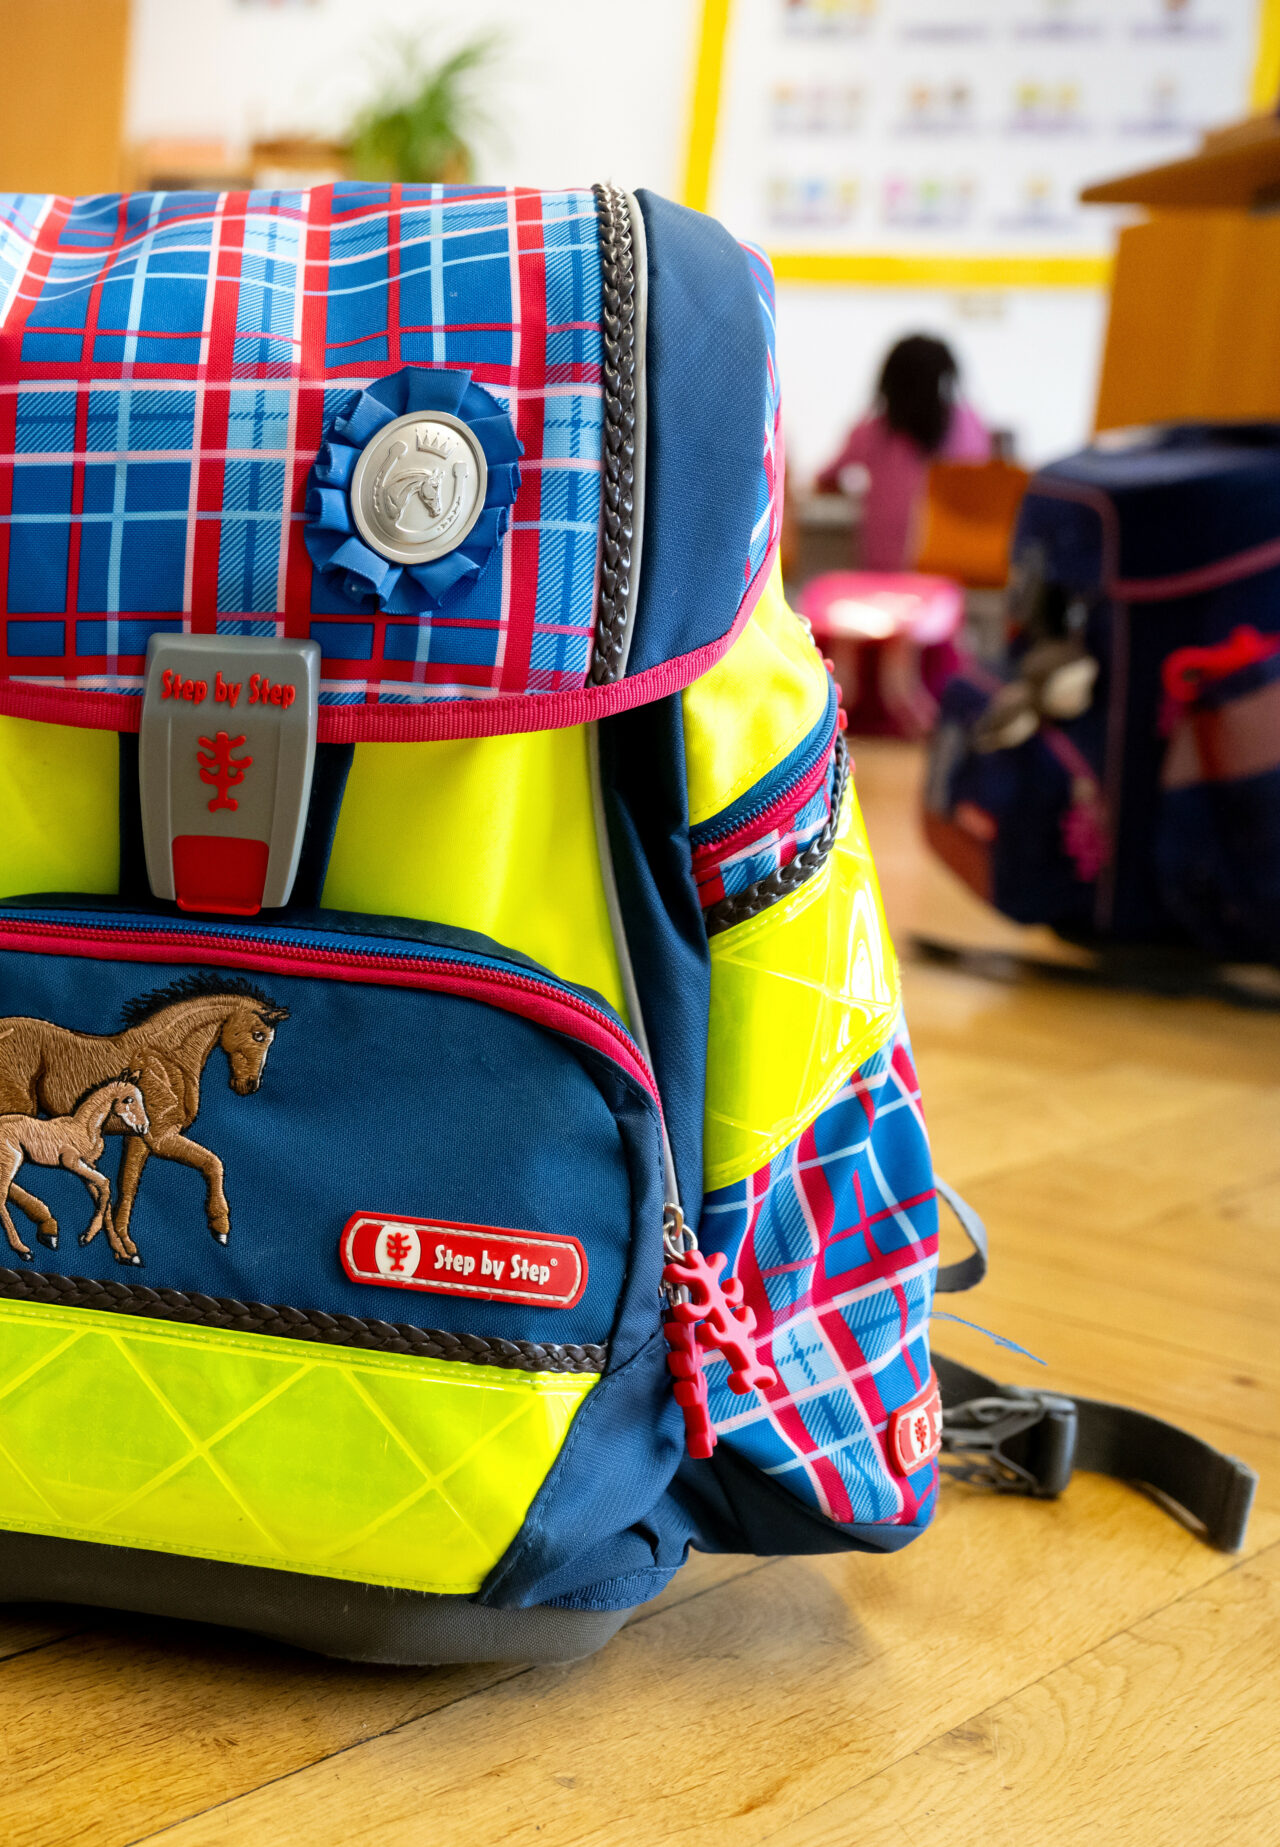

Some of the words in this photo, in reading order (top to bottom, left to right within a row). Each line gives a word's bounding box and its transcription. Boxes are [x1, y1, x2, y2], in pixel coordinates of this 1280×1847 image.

[161, 668, 208, 705] Step
[214, 671, 242, 708] by
[248, 673, 296, 710] Step
[433, 1244, 476, 1276] Step
[480, 1249, 506, 1281] by
